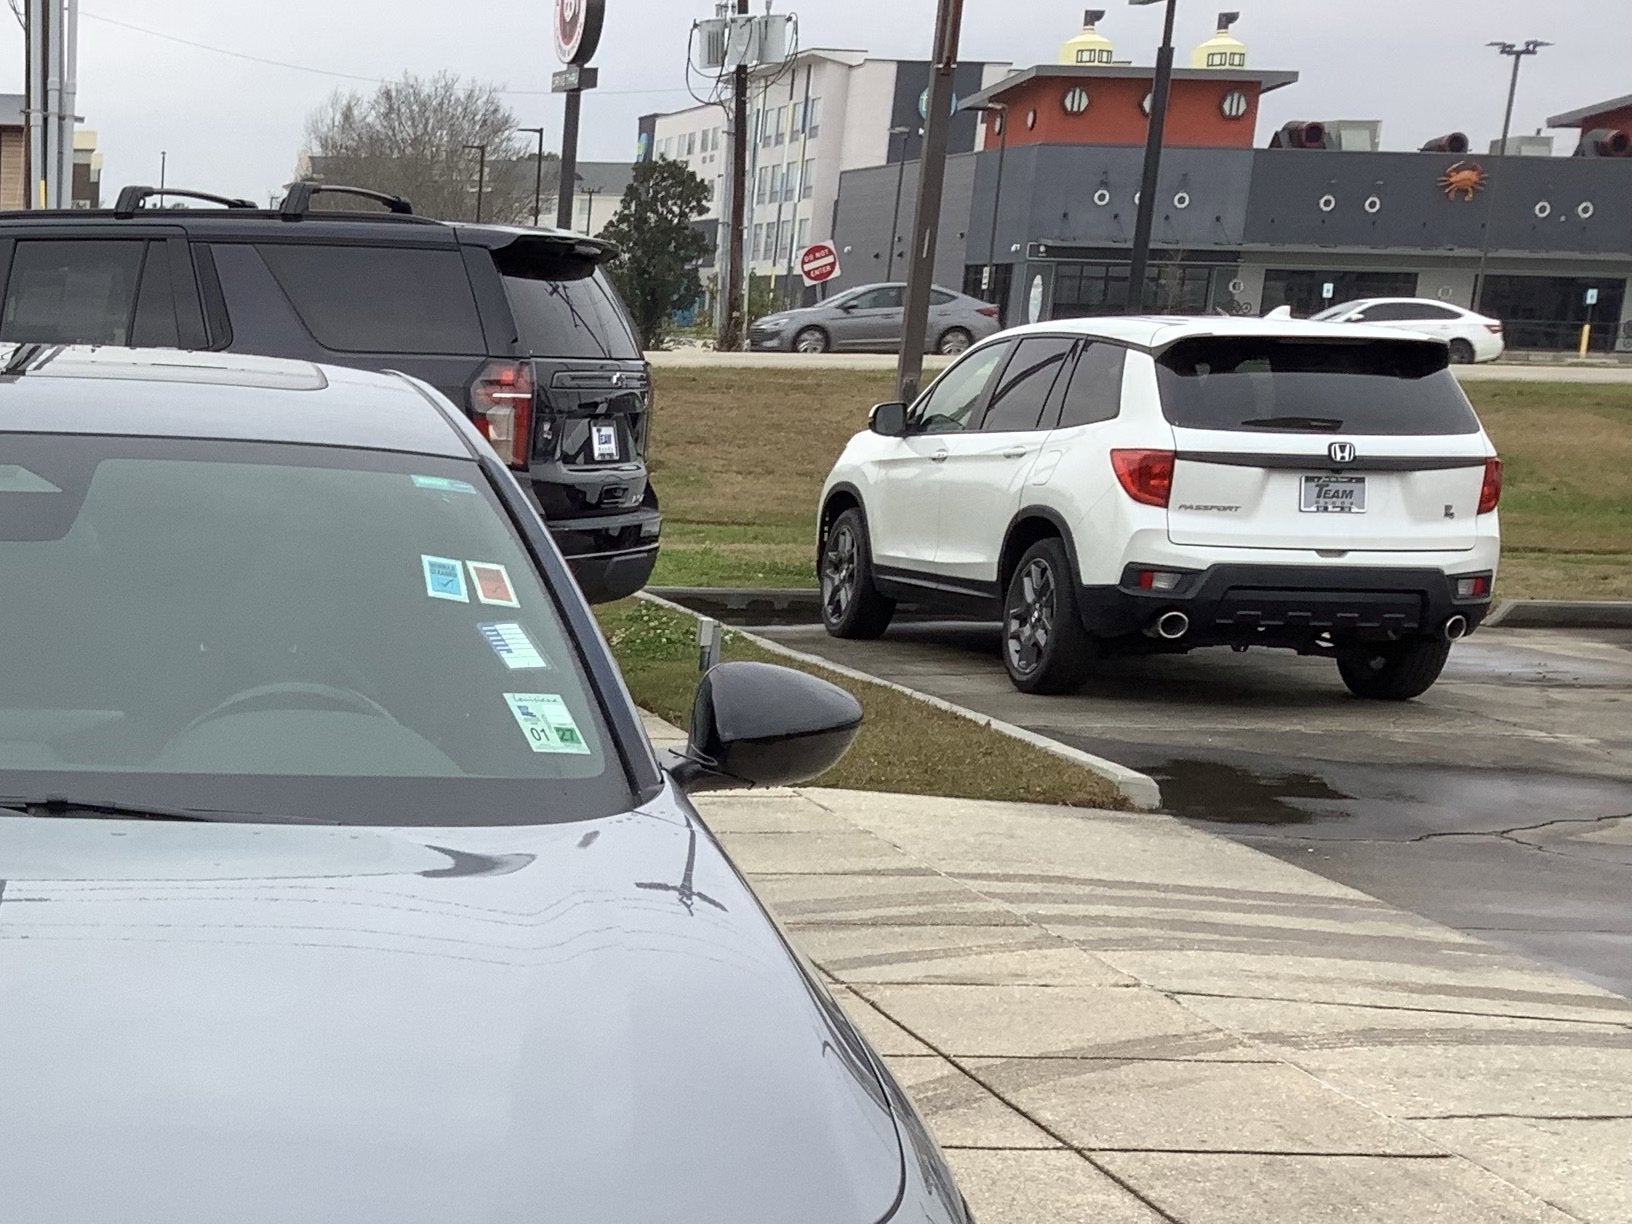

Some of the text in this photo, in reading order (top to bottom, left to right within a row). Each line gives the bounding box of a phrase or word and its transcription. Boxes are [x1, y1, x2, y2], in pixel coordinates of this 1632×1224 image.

[804, 249, 829, 262] DO NOT
[810, 265, 832, 277] ENTER
[1315, 482, 1355, 500] TEAM
[1178, 504, 1241, 512] PASSPORT
[530, 727, 550, 742] 01
